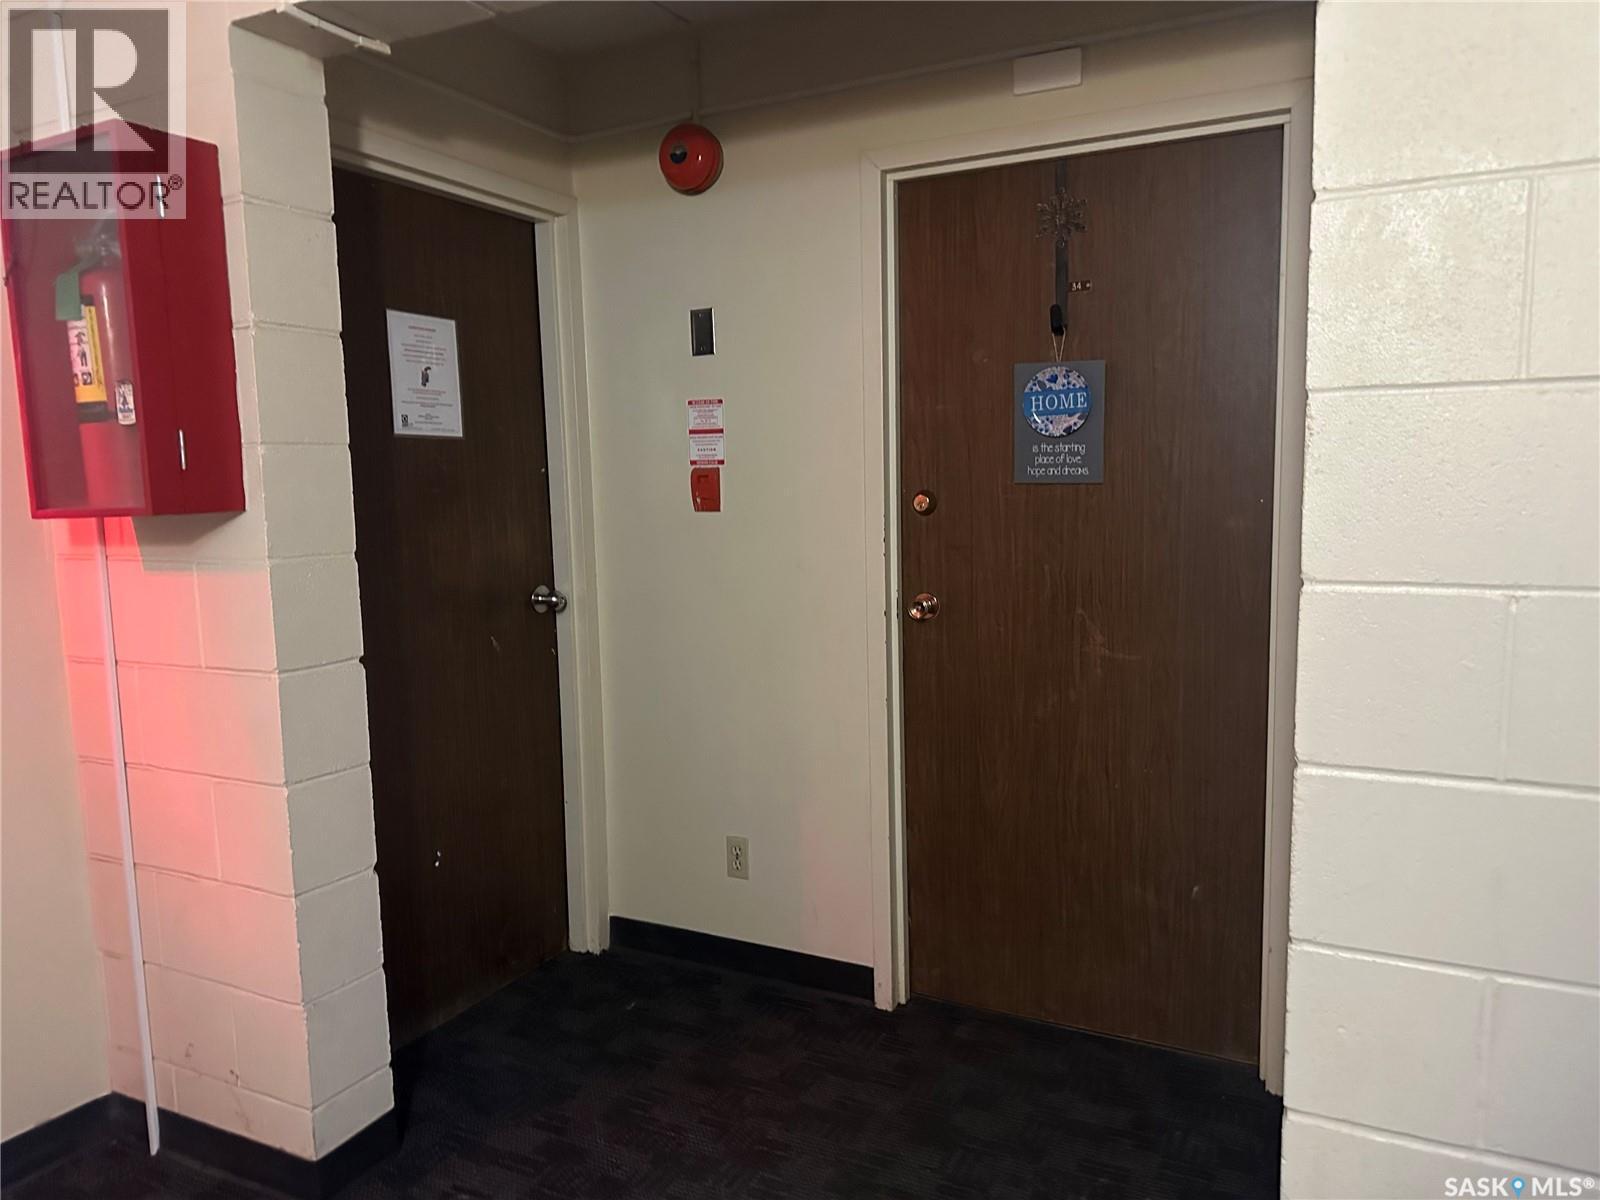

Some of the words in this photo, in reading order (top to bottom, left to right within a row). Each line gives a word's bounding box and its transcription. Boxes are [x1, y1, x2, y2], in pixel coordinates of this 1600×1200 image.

[1030, 392, 1088, 412] HOME
[1032, 444, 1039, 452] is
[1041, 442, 1053, 452] the
[1055, 442, 1086, 455] starting
[1035, 454, 1054, 466] place
[1056, 453, 1065, 463] of
[1028, 465, 1045, 478] hope
[1047, 466, 1060, 475] and
